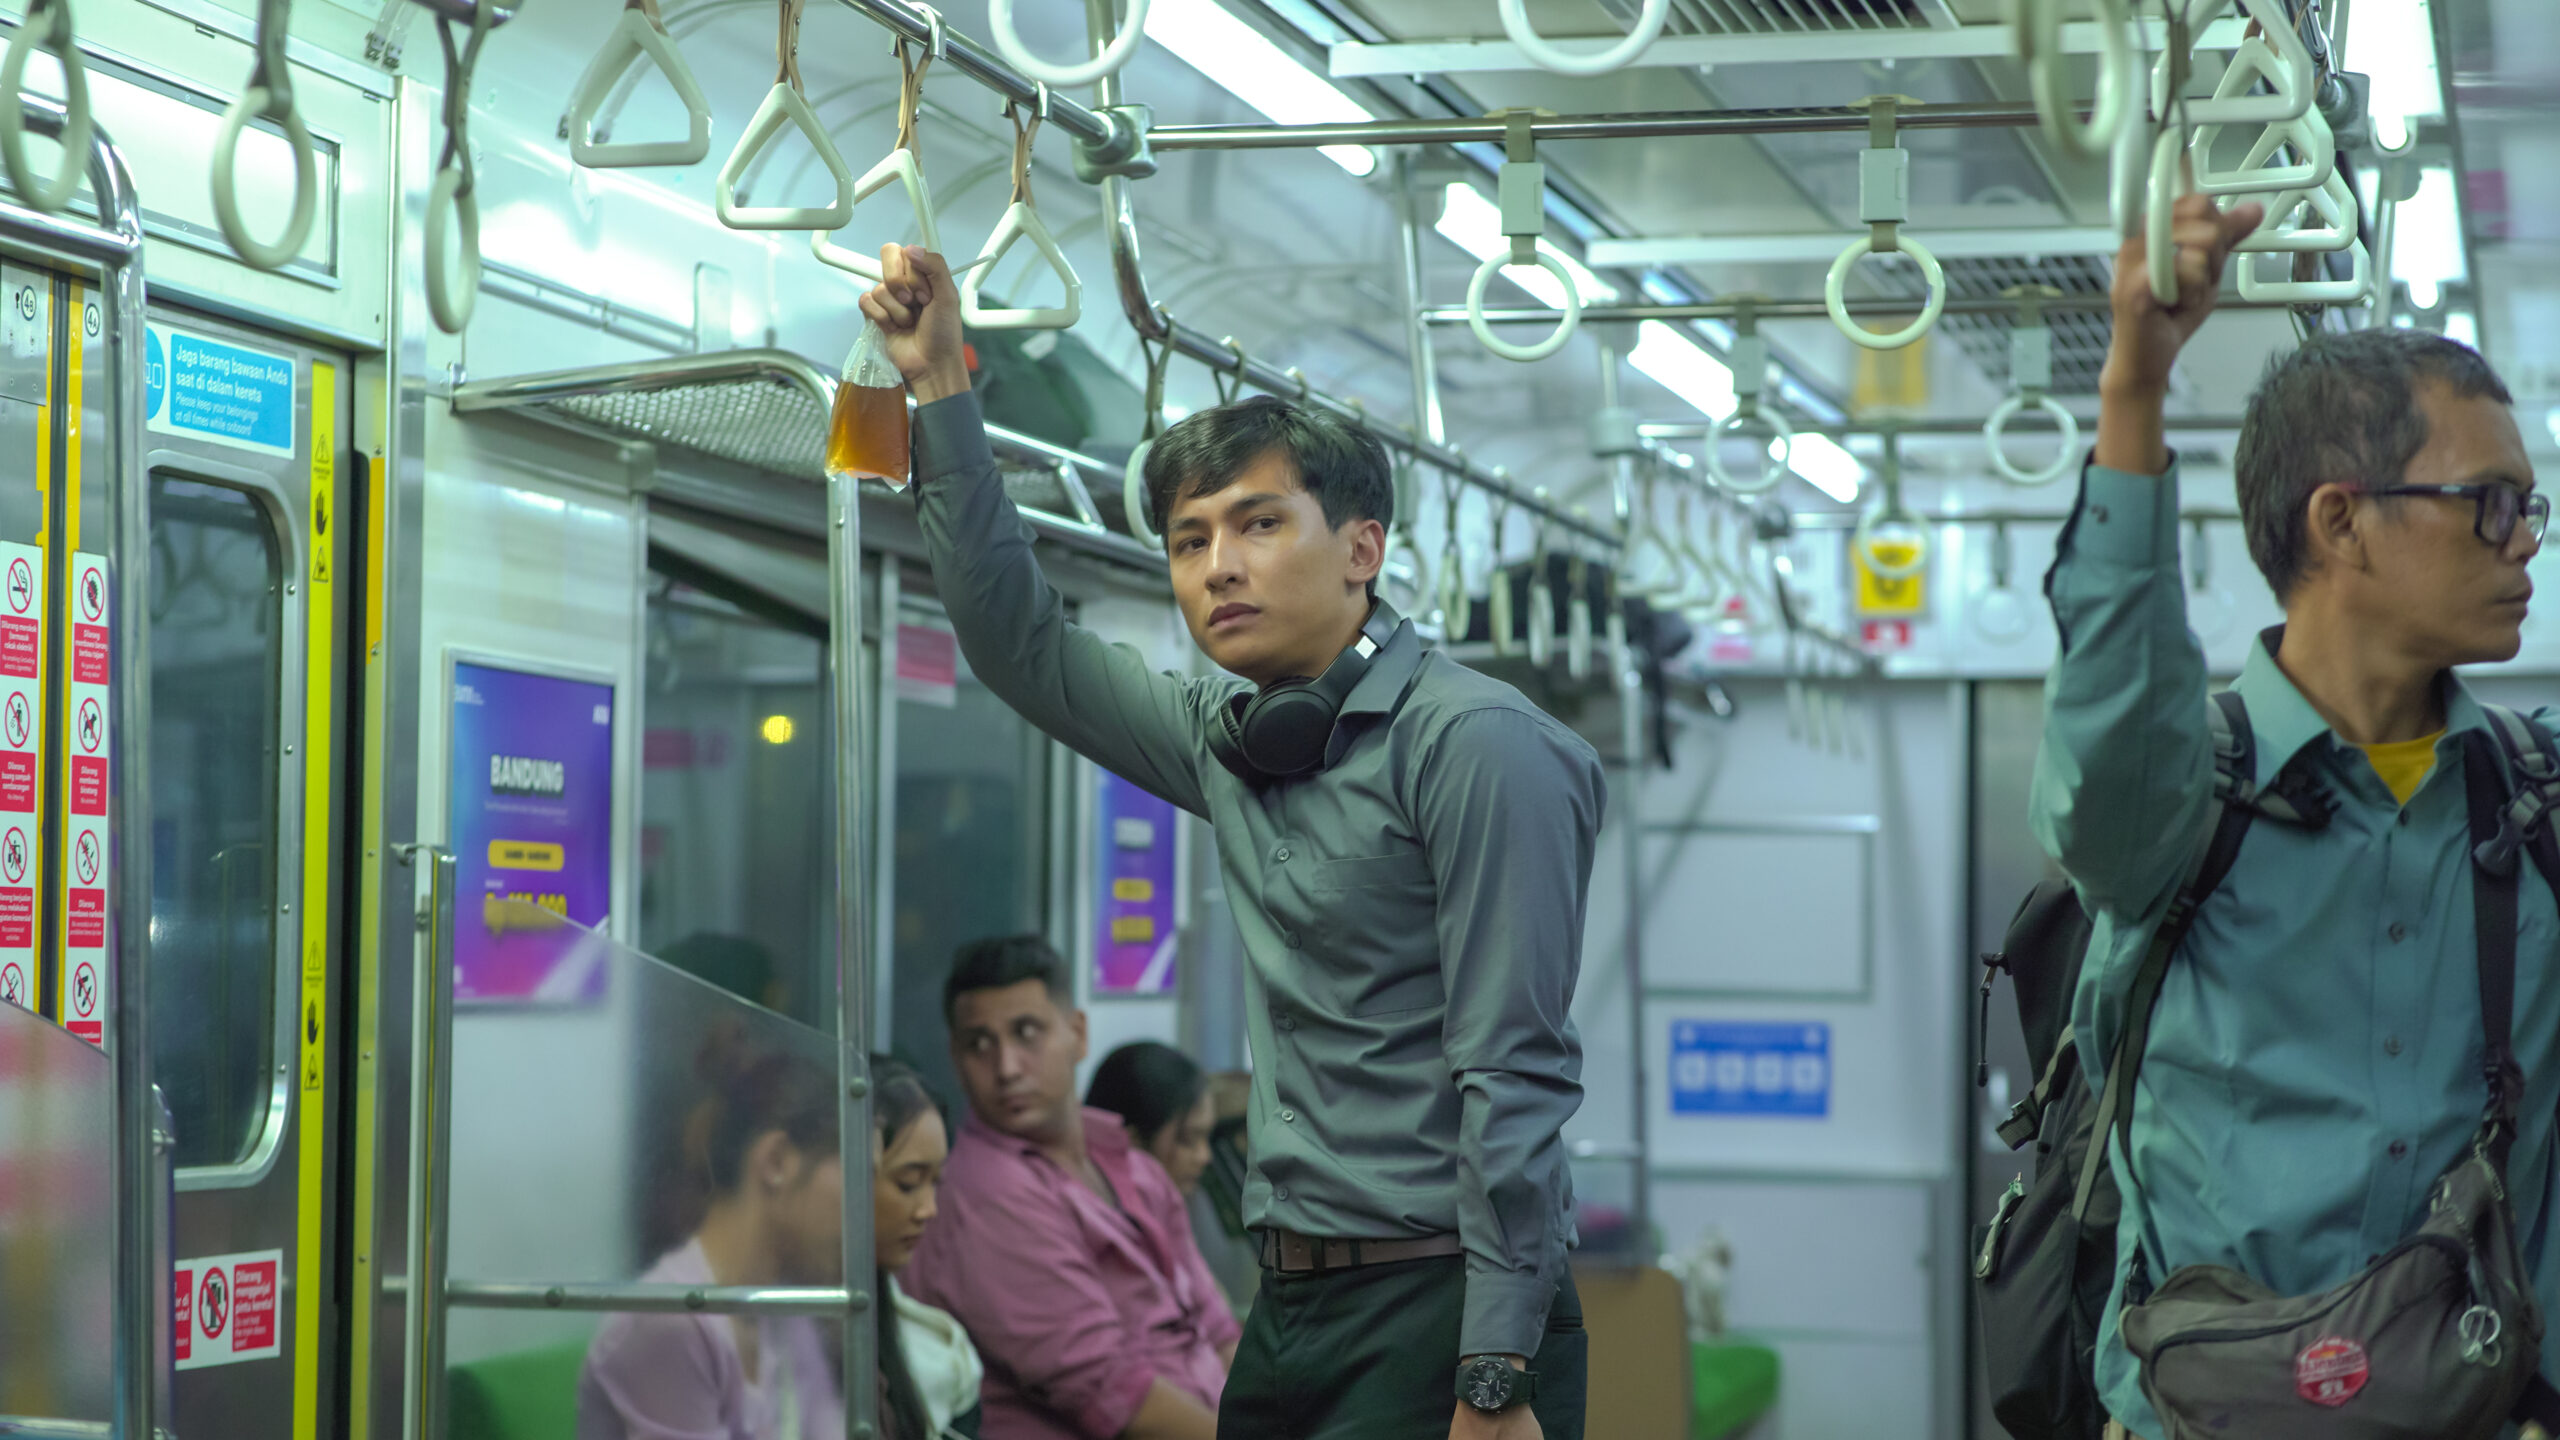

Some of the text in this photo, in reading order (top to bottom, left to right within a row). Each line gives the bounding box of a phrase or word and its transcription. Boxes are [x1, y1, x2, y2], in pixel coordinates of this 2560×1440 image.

[176, 344, 288, 387] Jaga barang bawaan Anda
[176, 372, 262, 403] saat di dalam kereta
[175, 392, 259, 424] Please keep your belongings
[192, 412, 209, 427] times
[1, 620, 37, 633] Dilarang merokok
[83, 629, 100, 641] Dilarang
[75, 639, 94, 648] membawa
[8, 761, 26, 773] Dilarang
[81, 765, 98, 777] Dilarang
[490, 754, 565, 791] BANDUNG
[1, 772, 31, 782] buang sampah
[79, 777, 100, 785] membawa
[2, 783, 30, 792] sembarangan
[80, 785, 98, 797] binatang
[78, 899, 96, 910] Dilarang
[235, 1270, 262, 1284] Dilarang
[235, 1301, 251, 1315] pintu
